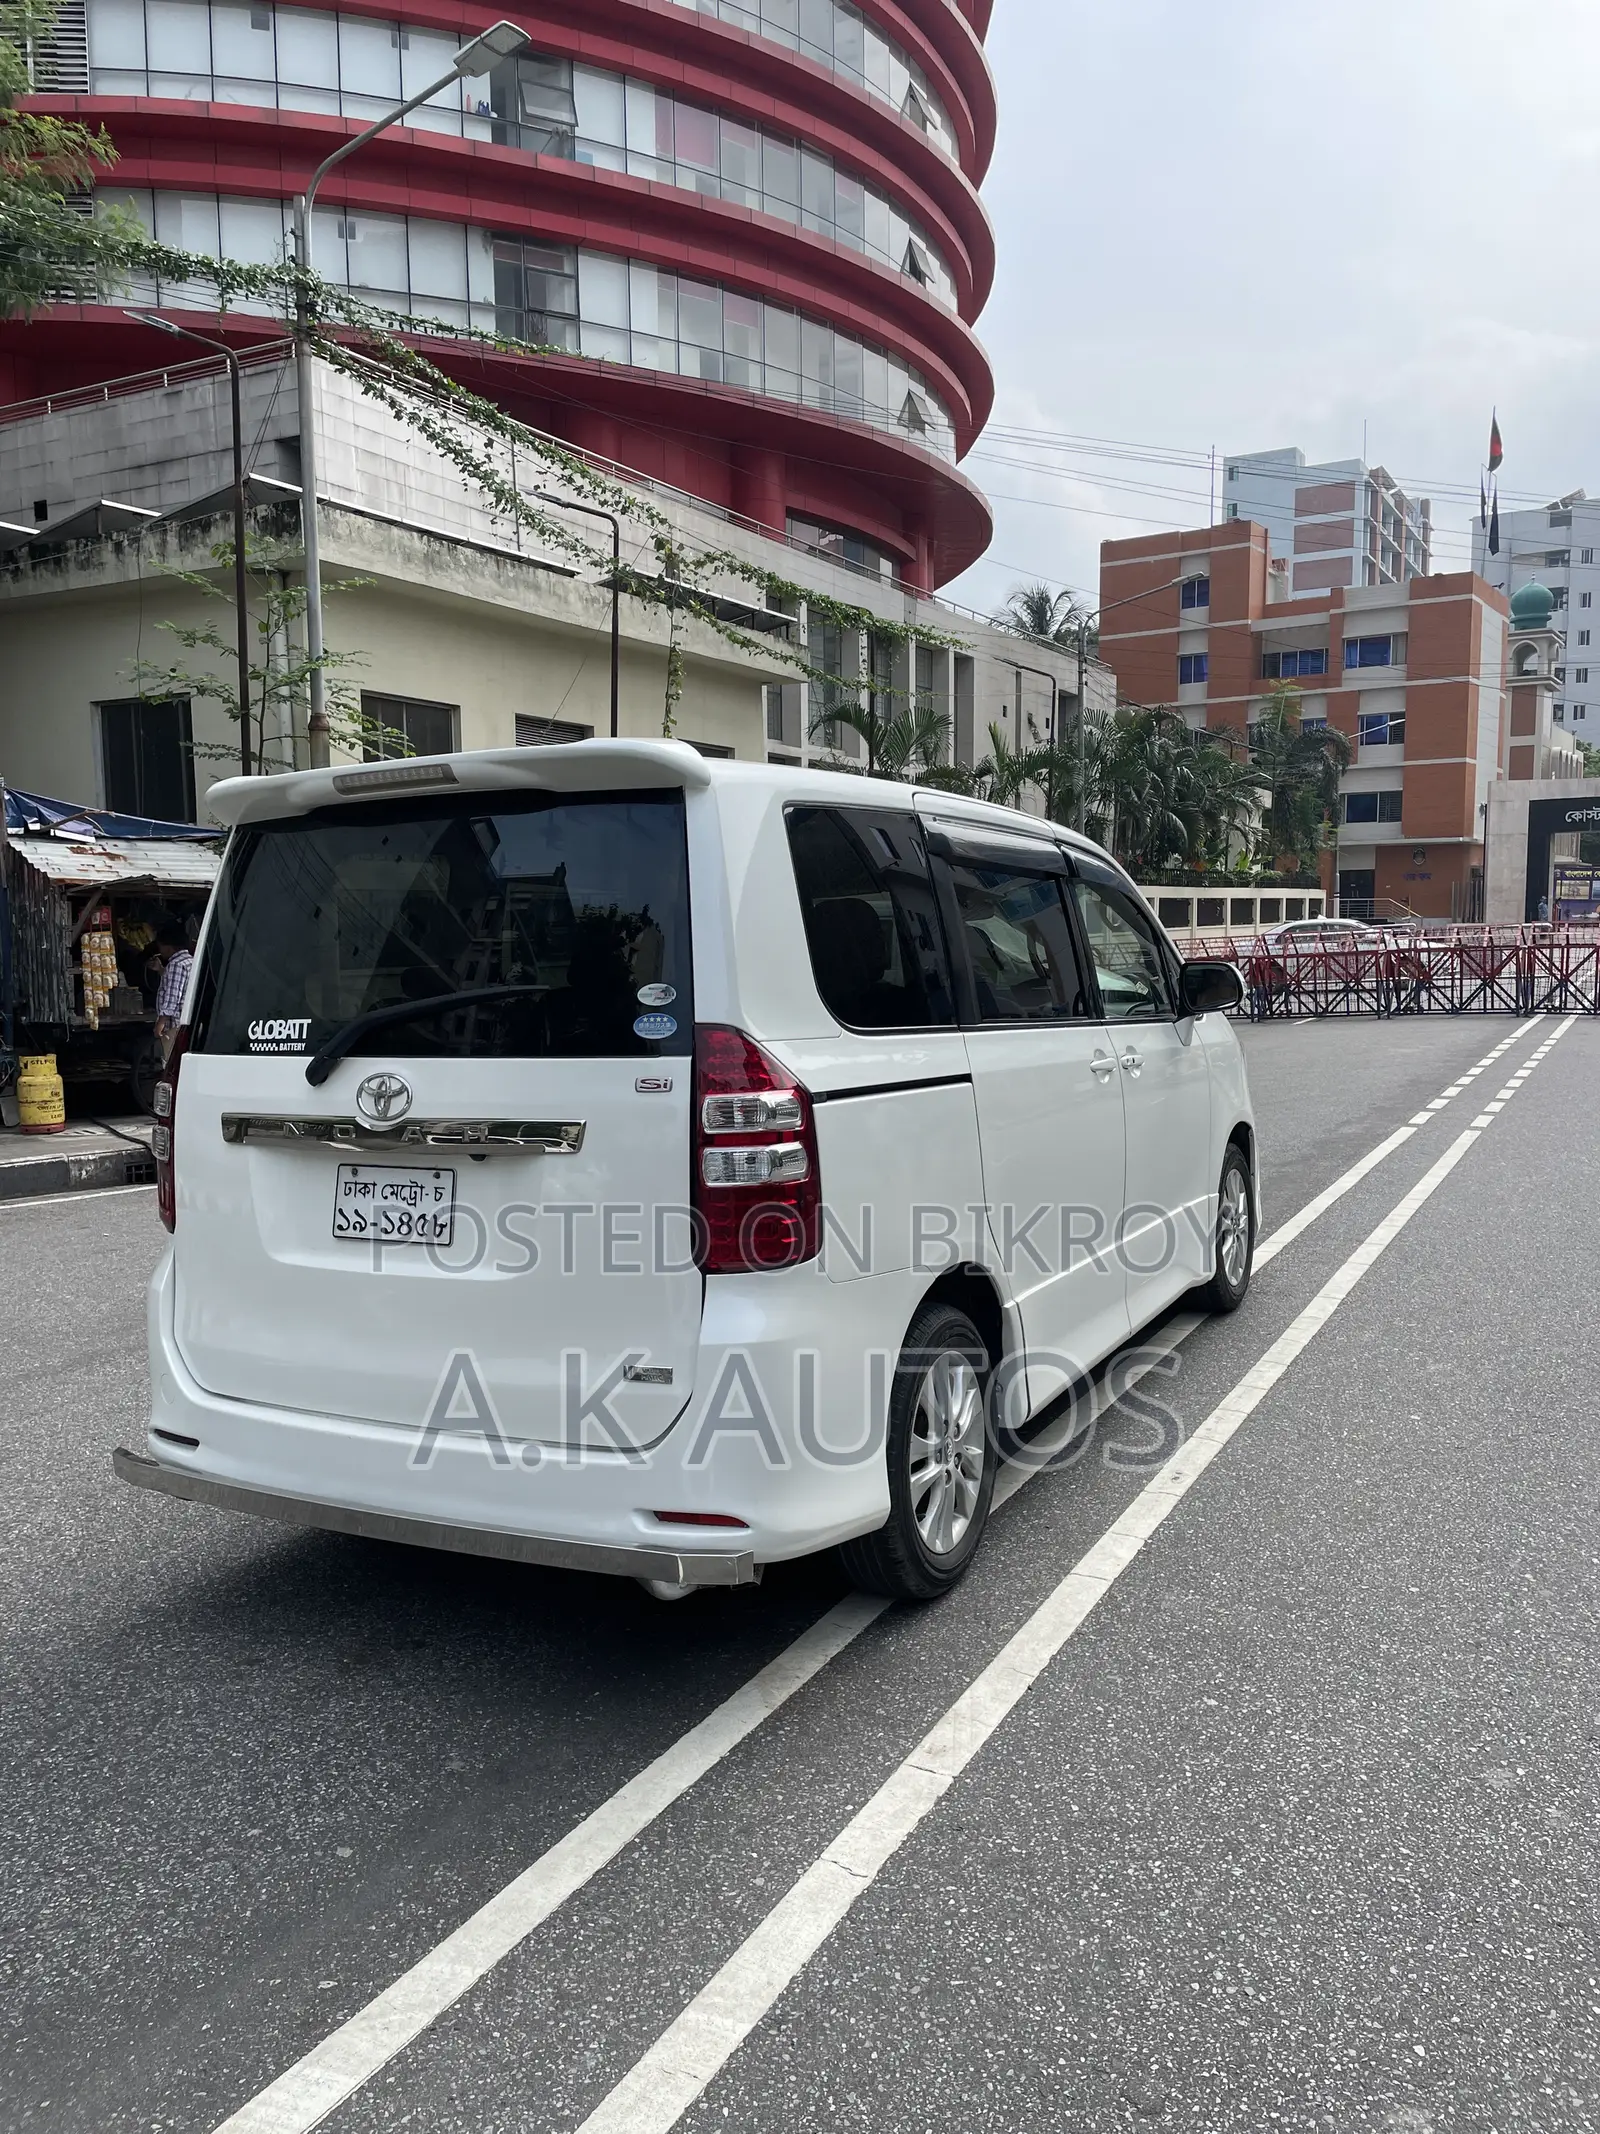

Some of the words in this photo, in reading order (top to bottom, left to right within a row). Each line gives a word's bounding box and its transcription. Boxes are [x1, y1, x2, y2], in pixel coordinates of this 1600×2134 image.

[248, 1018, 312, 1040] GLOBATT
[279, 1043, 306, 1052] BATTERY
[639, 1078, 669, 1090] Si
[343, 1180, 377, 1199] ঢাকা
[336, 1207, 448, 1238] ১৯-১৪৫৮
